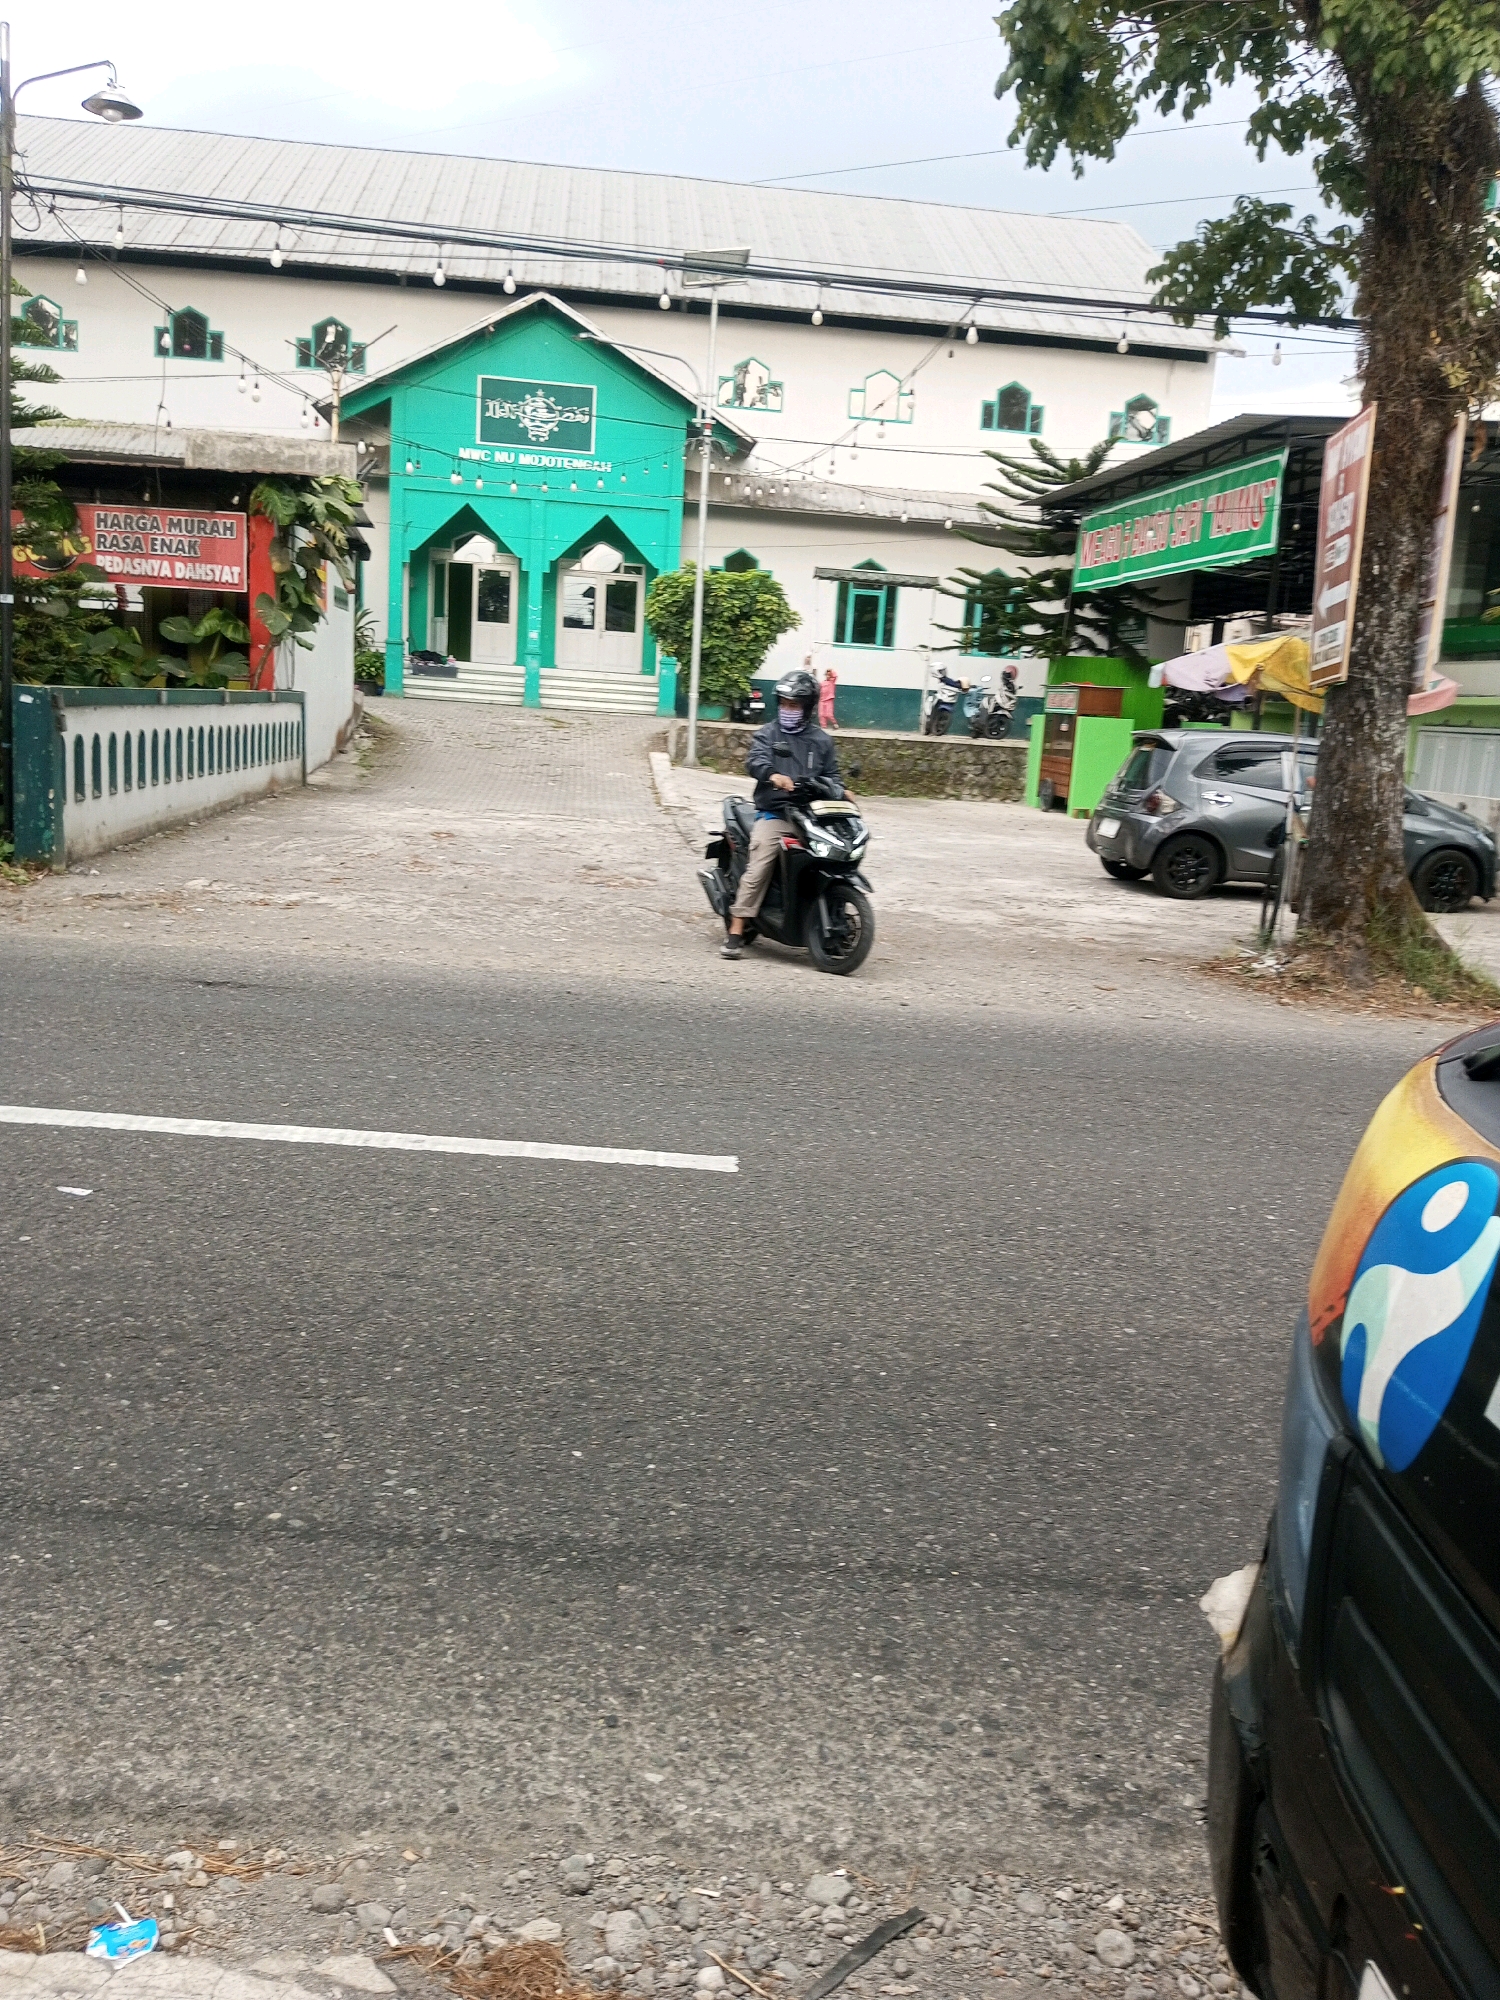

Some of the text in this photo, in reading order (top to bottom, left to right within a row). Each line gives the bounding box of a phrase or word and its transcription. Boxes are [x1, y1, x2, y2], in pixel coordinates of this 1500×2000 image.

[458, 447, 491, 461] MWC
[494, 450, 515, 463] NU
[95, 511, 162, 533] HARGA
[167, 516, 237, 538] MURAH
[1170, 498, 1205, 548] SAPI
[95, 534, 145, 554] RASA
[150, 536, 201, 557] ENAK
[96, 555, 241, 584] PEDASNYA DAHSYAT
